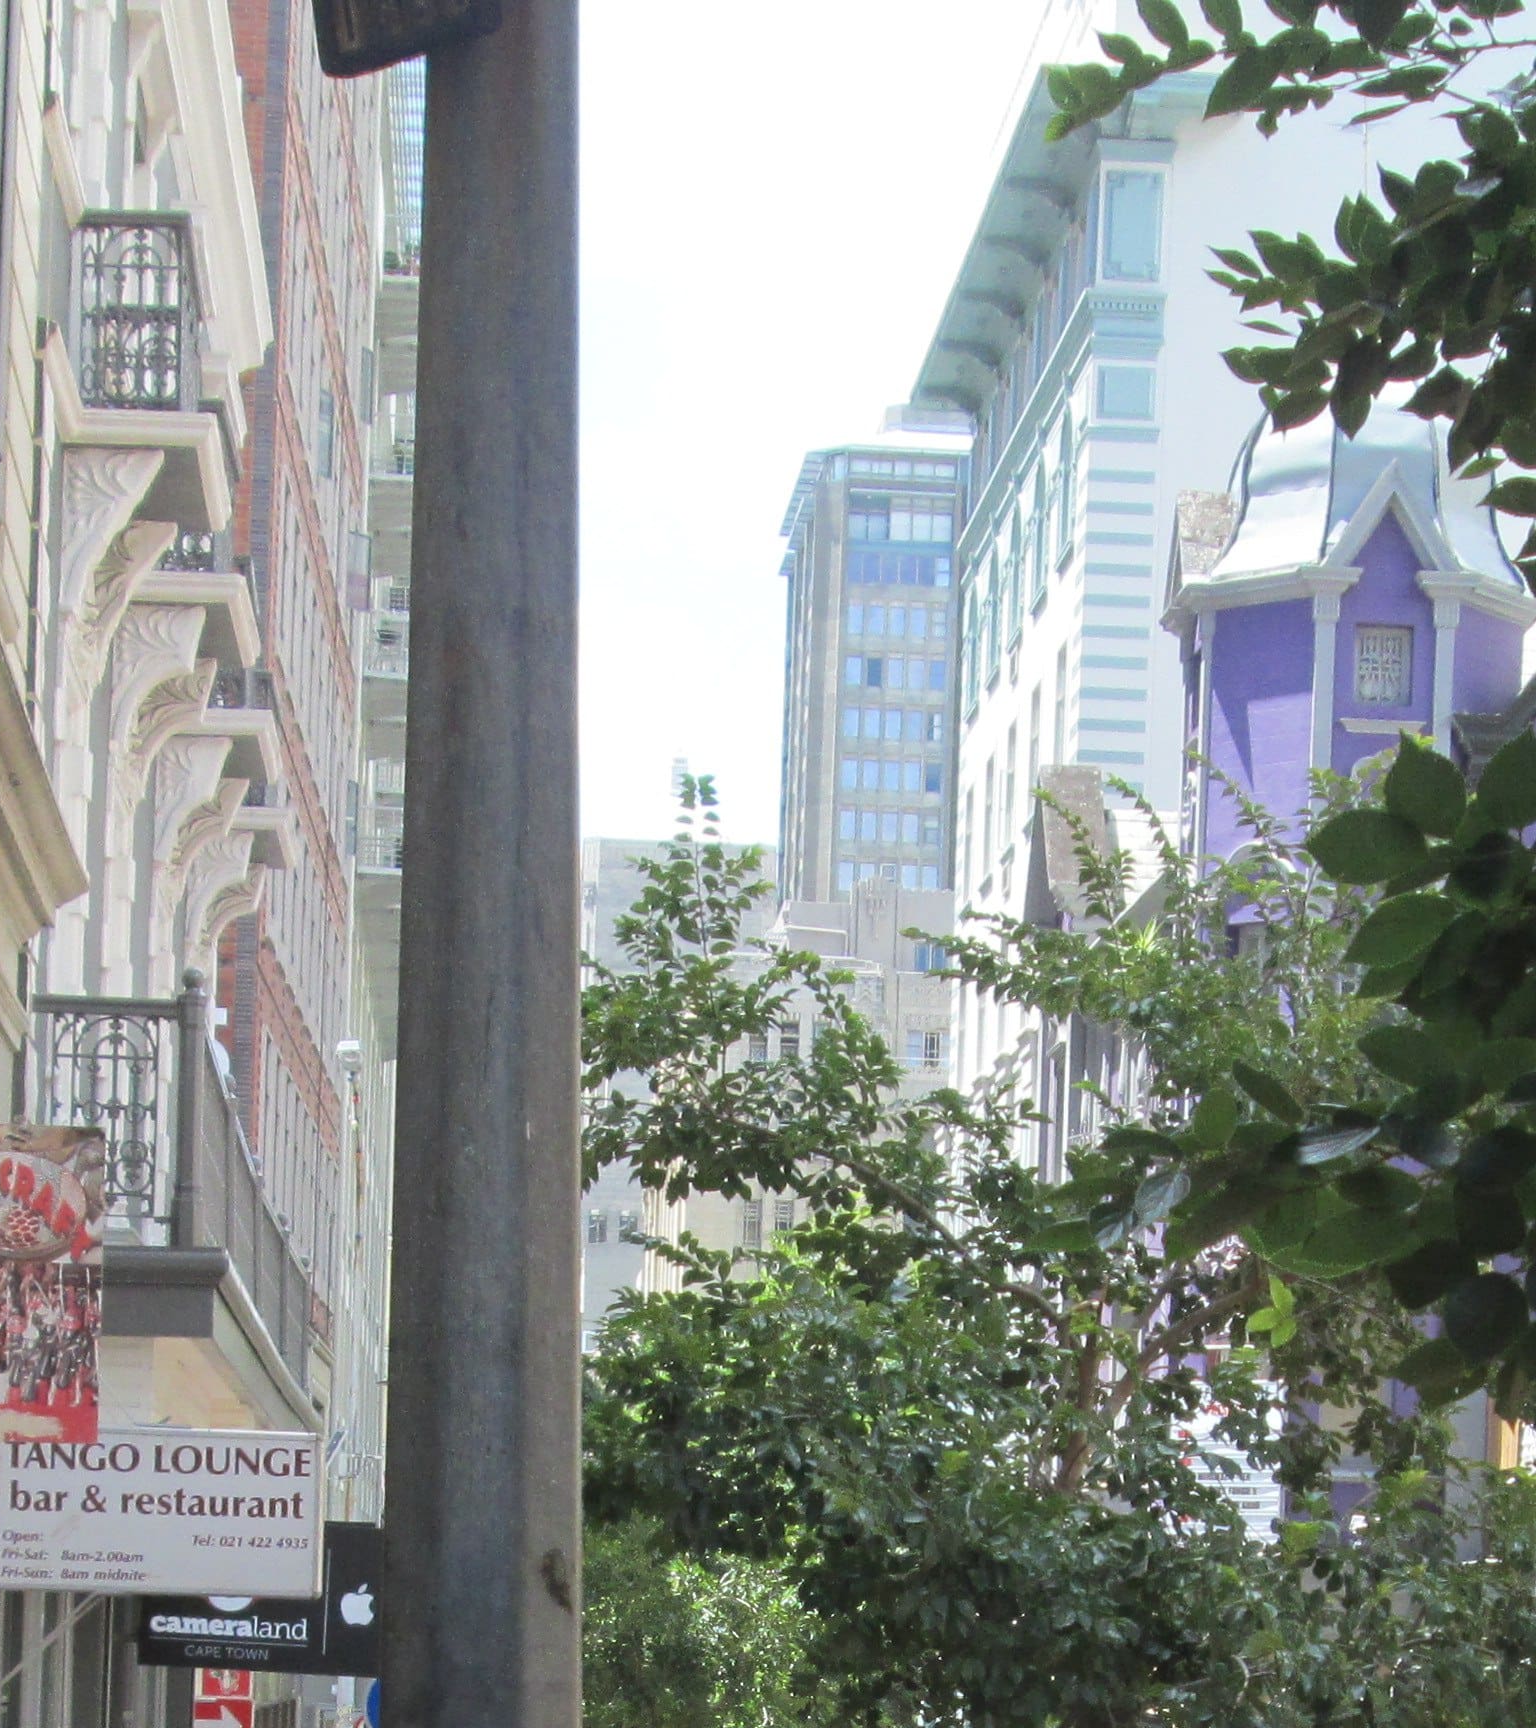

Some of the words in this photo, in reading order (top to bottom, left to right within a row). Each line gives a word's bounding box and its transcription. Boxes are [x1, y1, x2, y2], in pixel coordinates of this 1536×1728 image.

[4, 1441, 141, 1473] TANGO
[154, 1444, 311, 1477] LOUNGE
[9, 1479, 69, 1512] bar
[80, 1484, 107, 1513] &
[120, 1487, 304, 1520] restaurant
[2, 1529, 44, 1544] Open:
[192, 1534, 216, 1548] Tel:
[219, 1535, 243, 1548] 021
[248, 1536, 272, 1549] 422
[276, 1538, 309, 1550] 4935
[60, 1567, 89, 1580] 8am
[93, 1568, 147, 1581] midnite
[149, 1614, 308, 1641] cameraland
[183, 1645, 222, 1659] CAPE
[226, 1647, 269, 1661] TOWN
